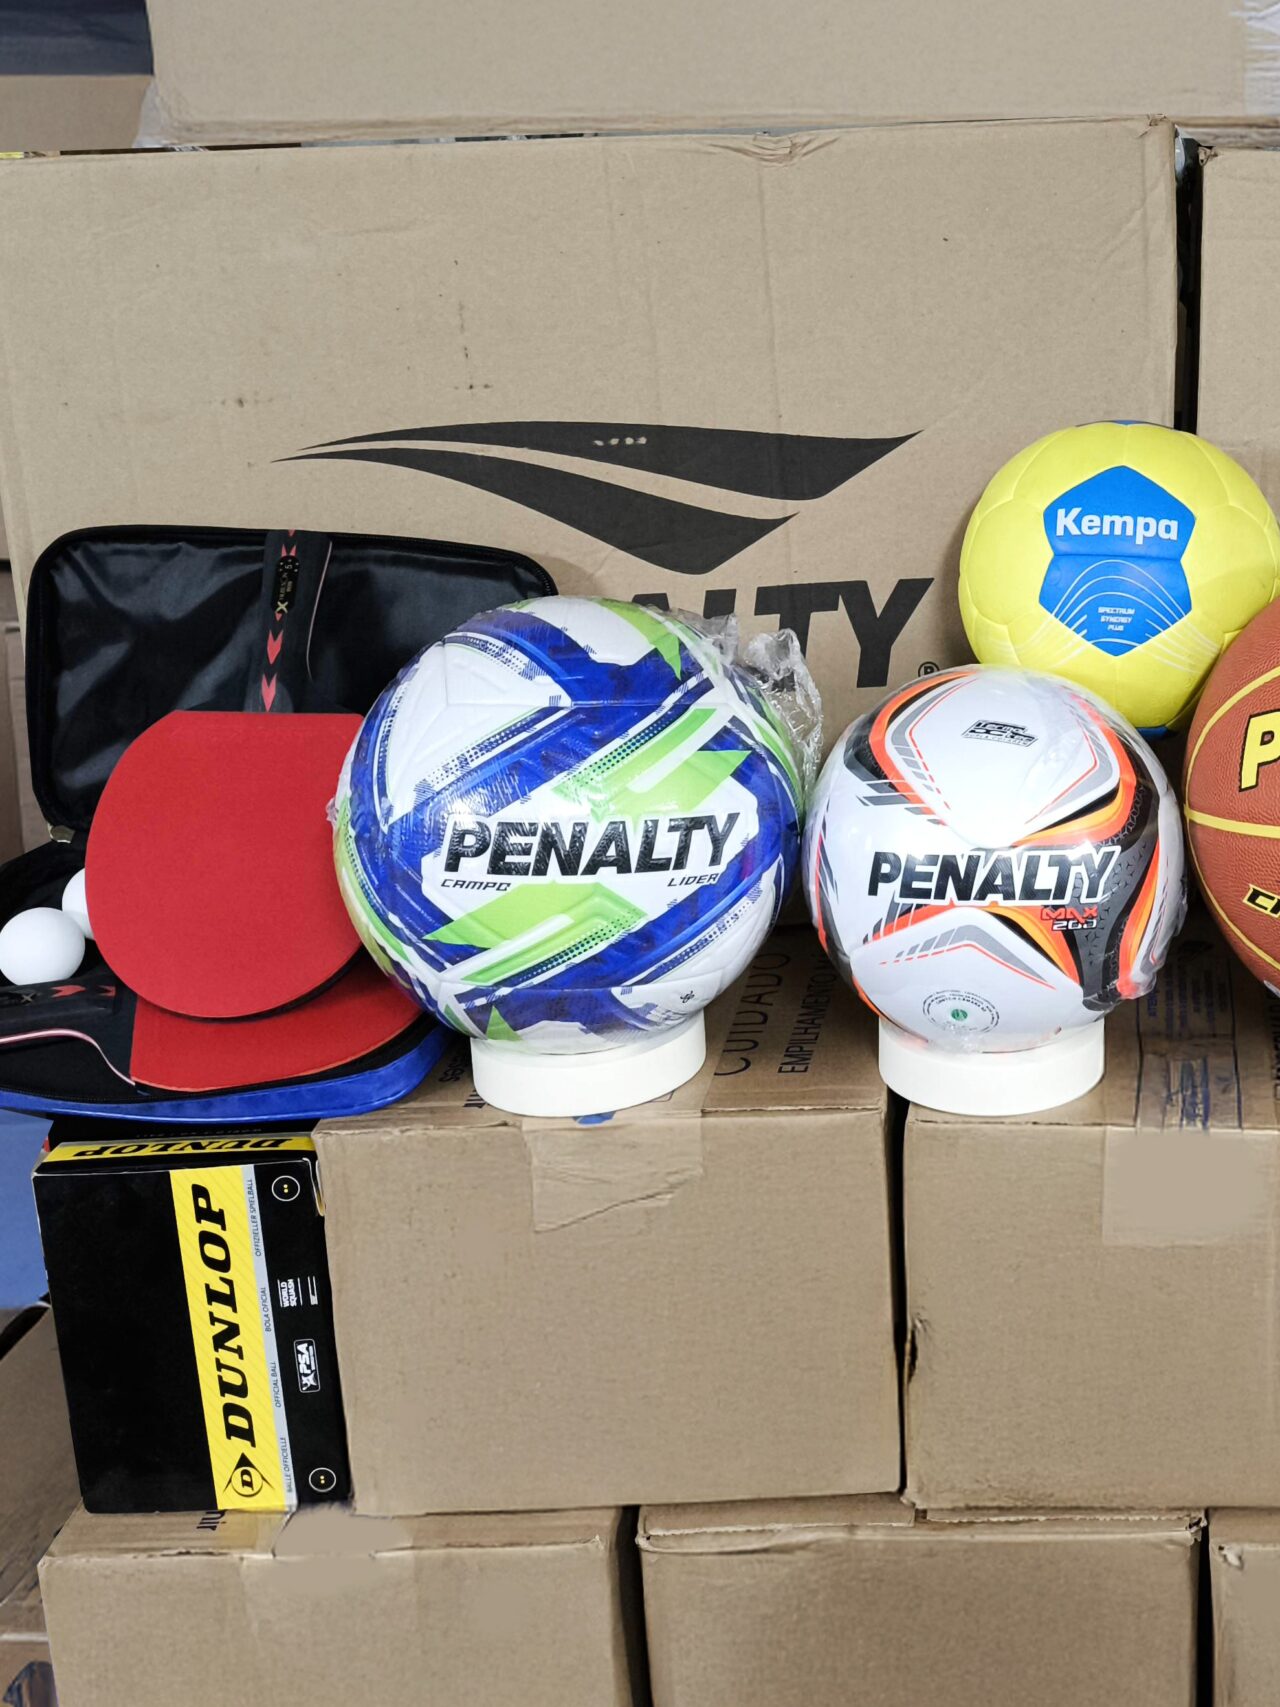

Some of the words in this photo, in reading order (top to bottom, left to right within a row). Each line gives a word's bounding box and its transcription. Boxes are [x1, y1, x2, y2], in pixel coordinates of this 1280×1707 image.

[1055, 506, 1179, 545] Kempa
[1097, 606, 1135, 616] SPECTRUM
[1107, 623, 1124, 632] PLUS
[442, 812, 741, 877] PENALTY
[441, 878, 512, 892] CAMPO
[867, 847, 1120, 903] PENALTY
[1041, 906, 1099, 924] MAX
[1051, 917, 1098, 931] 200
[777, 974, 837, 1074] EMPILHAMENTO
[73, 1135, 297, 1158] DUNLOP
[247, 1178, 257, 1213] SPIELBALL
[252, 1214, 262, 1257] OFFIZIELLER
[260, 1286, 269, 1310] OFICIAL
[280, 1281, 290, 1307] WORLD
[287, 1278, 298, 1307] SQUASH
[191, 1183, 256, 1448] DUNLOP
[264, 1311, 272, 1332] BOLA
[270, 1361, 278, 1377] BALL
[296, 1342, 311, 1374] PSA
[272, 1377, 282, 1408] OFFICIAL
[280, 1437, 290, 1472] OFFICIELLE
